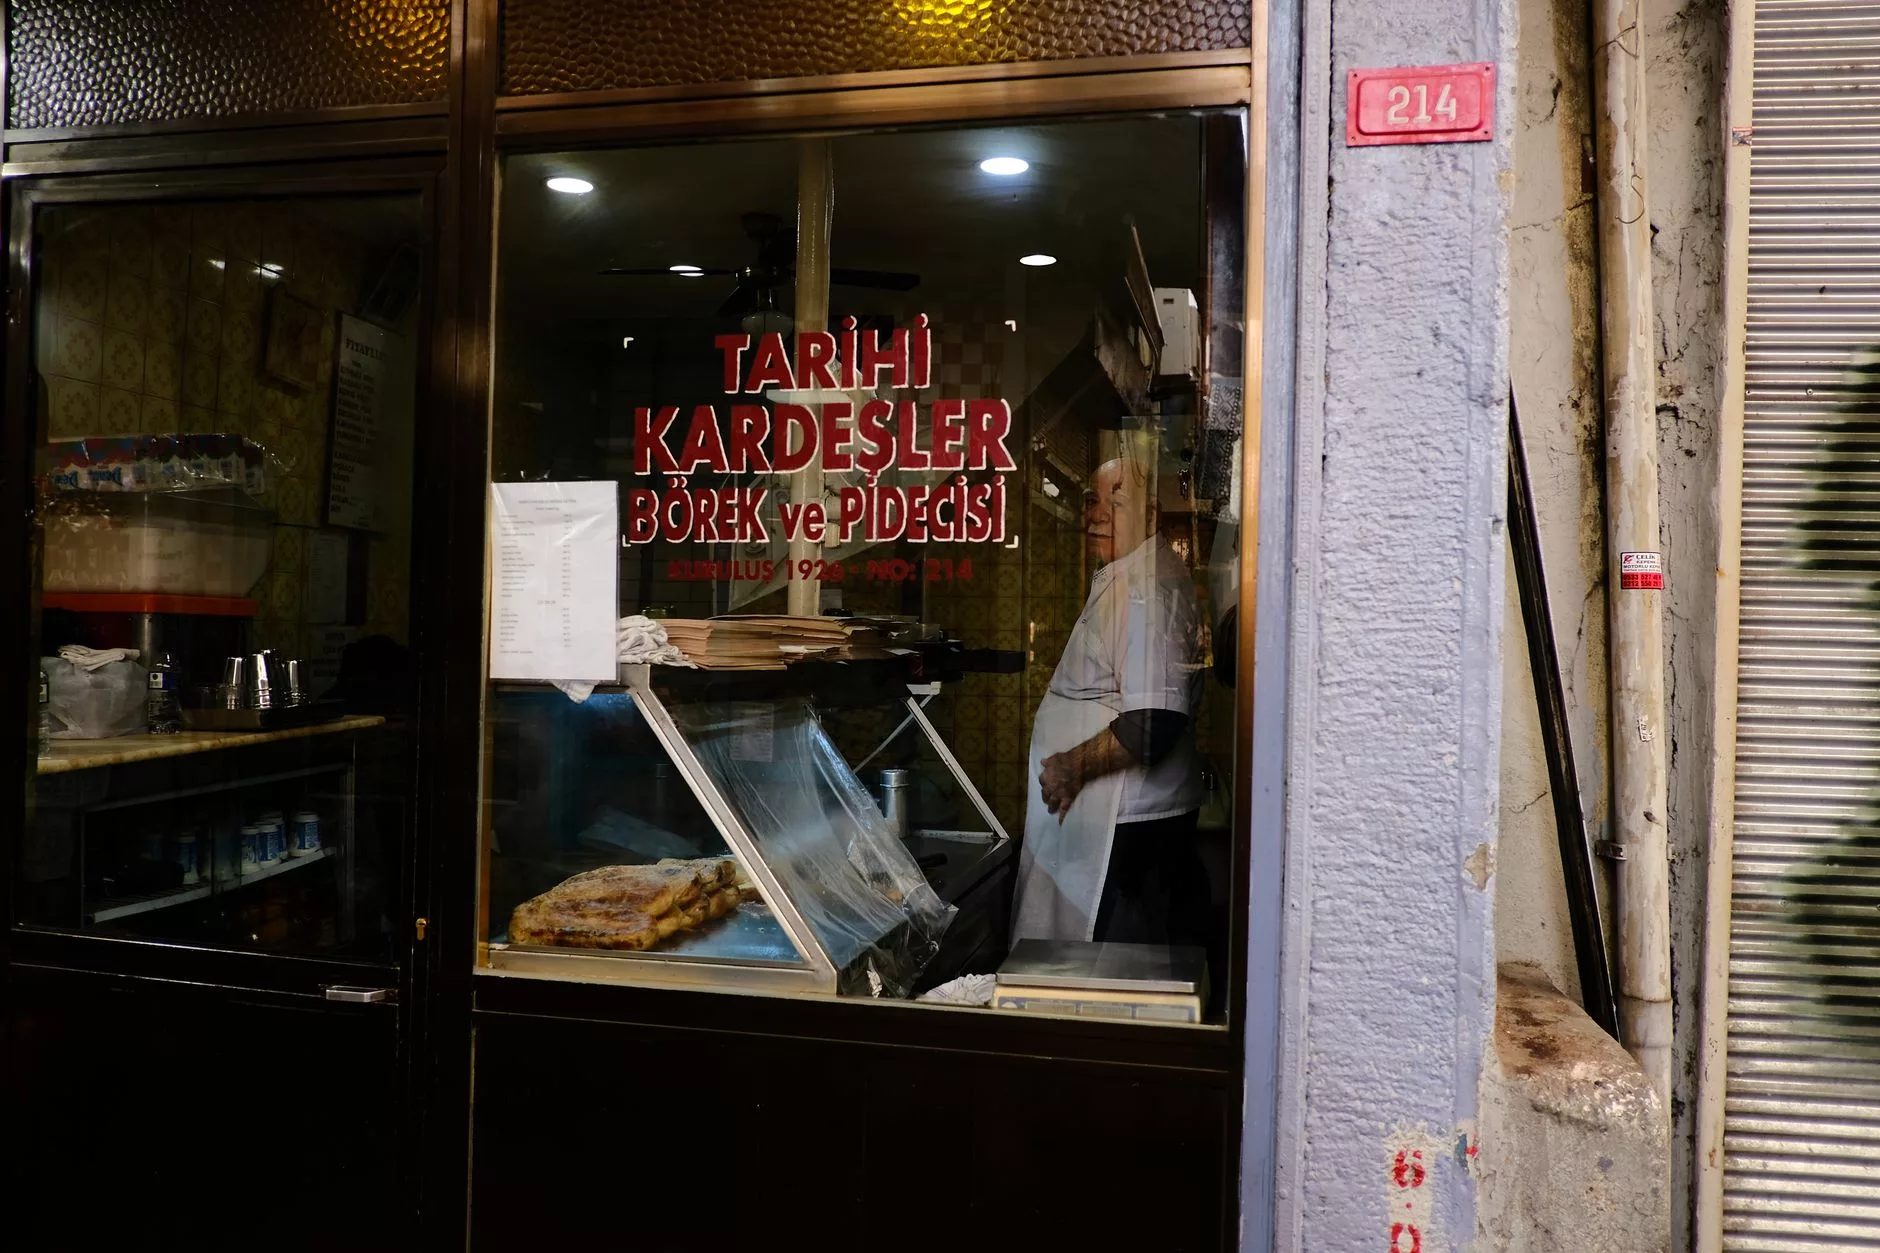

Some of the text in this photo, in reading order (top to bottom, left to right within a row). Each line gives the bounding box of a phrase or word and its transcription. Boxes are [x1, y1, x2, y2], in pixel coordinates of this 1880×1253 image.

[1387, 84, 1457, 125] 214
[714, 313, 931, 394] TARİHİ
[634, 398, 1017, 479] KARDEŞLER
[628, 475, 1006, 543] BÖREK ve PİDECİSİ
[667, 558, 974, 584] KURULUŞ 1926 NO: 214
